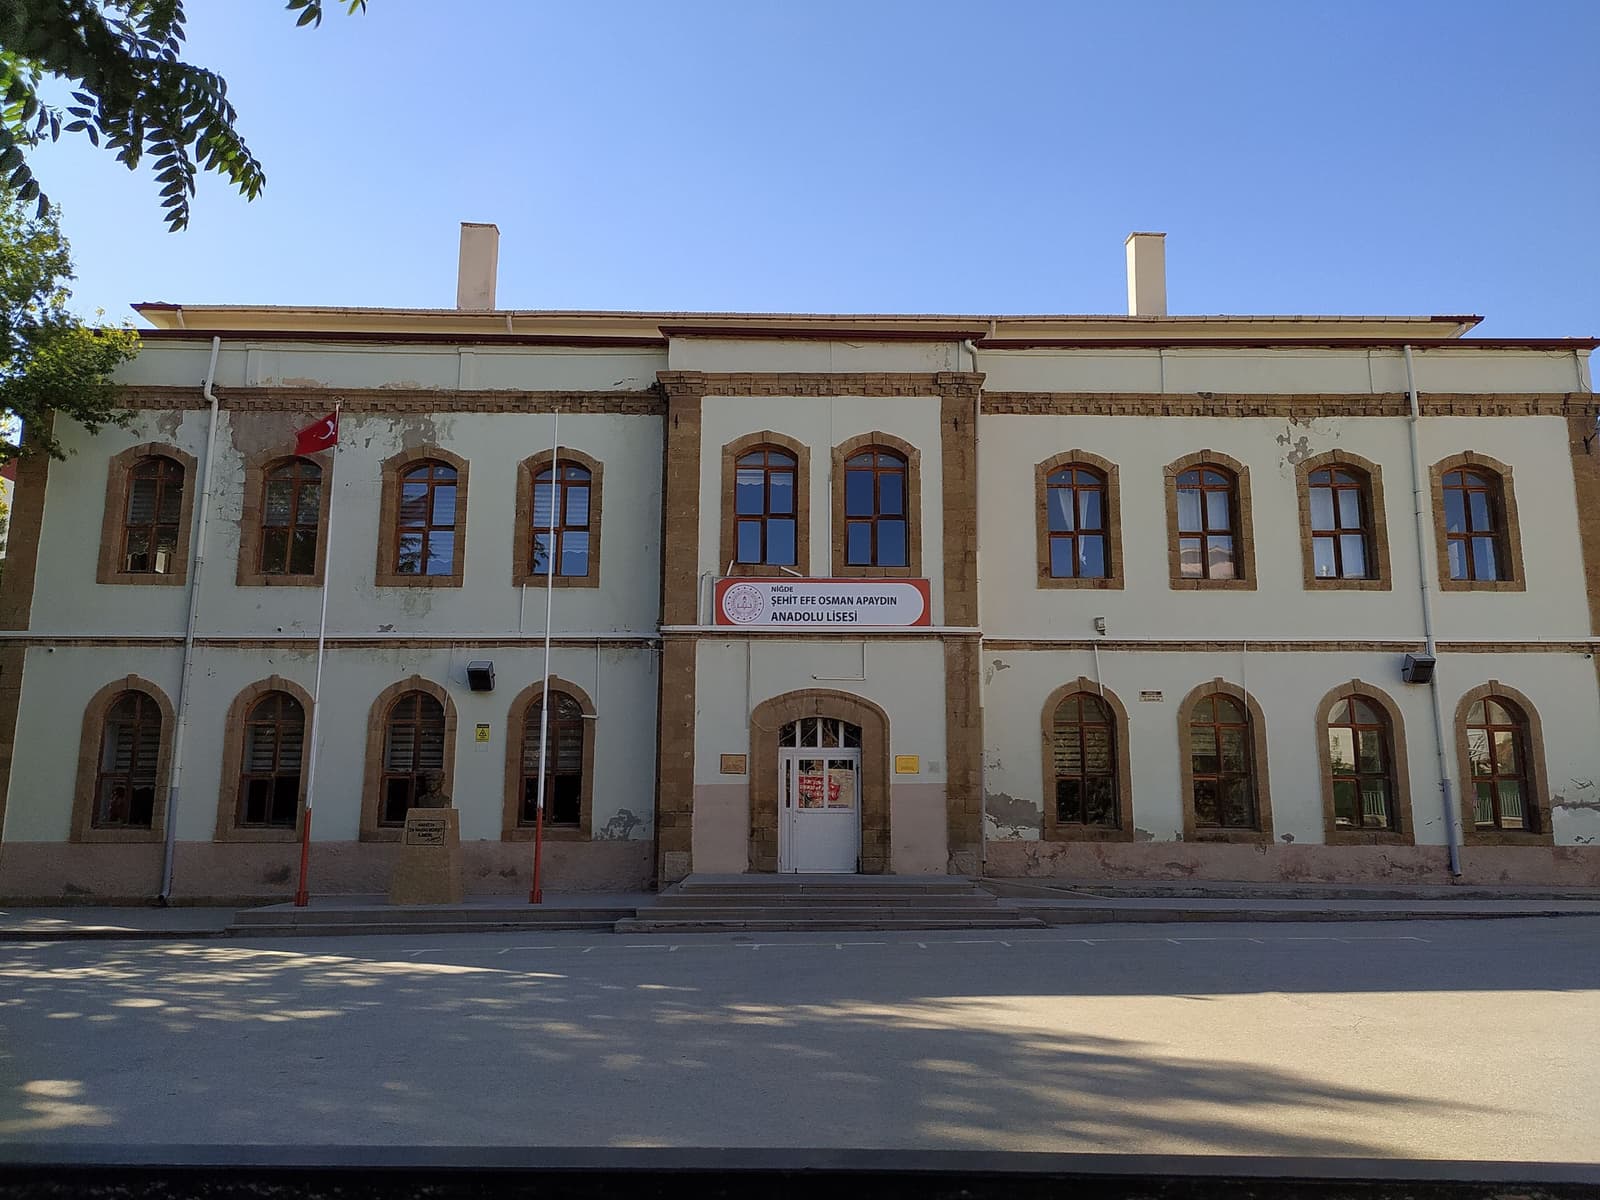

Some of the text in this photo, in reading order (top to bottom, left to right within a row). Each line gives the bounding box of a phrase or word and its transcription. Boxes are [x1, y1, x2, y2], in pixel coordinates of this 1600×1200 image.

[771, 585, 794, 593] NİĞDE
[771, 595, 897, 606] ŞEHİT EFE OSMAN APAYDIN
[771, 610, 858, 622] ANADOLU LİSESİ
